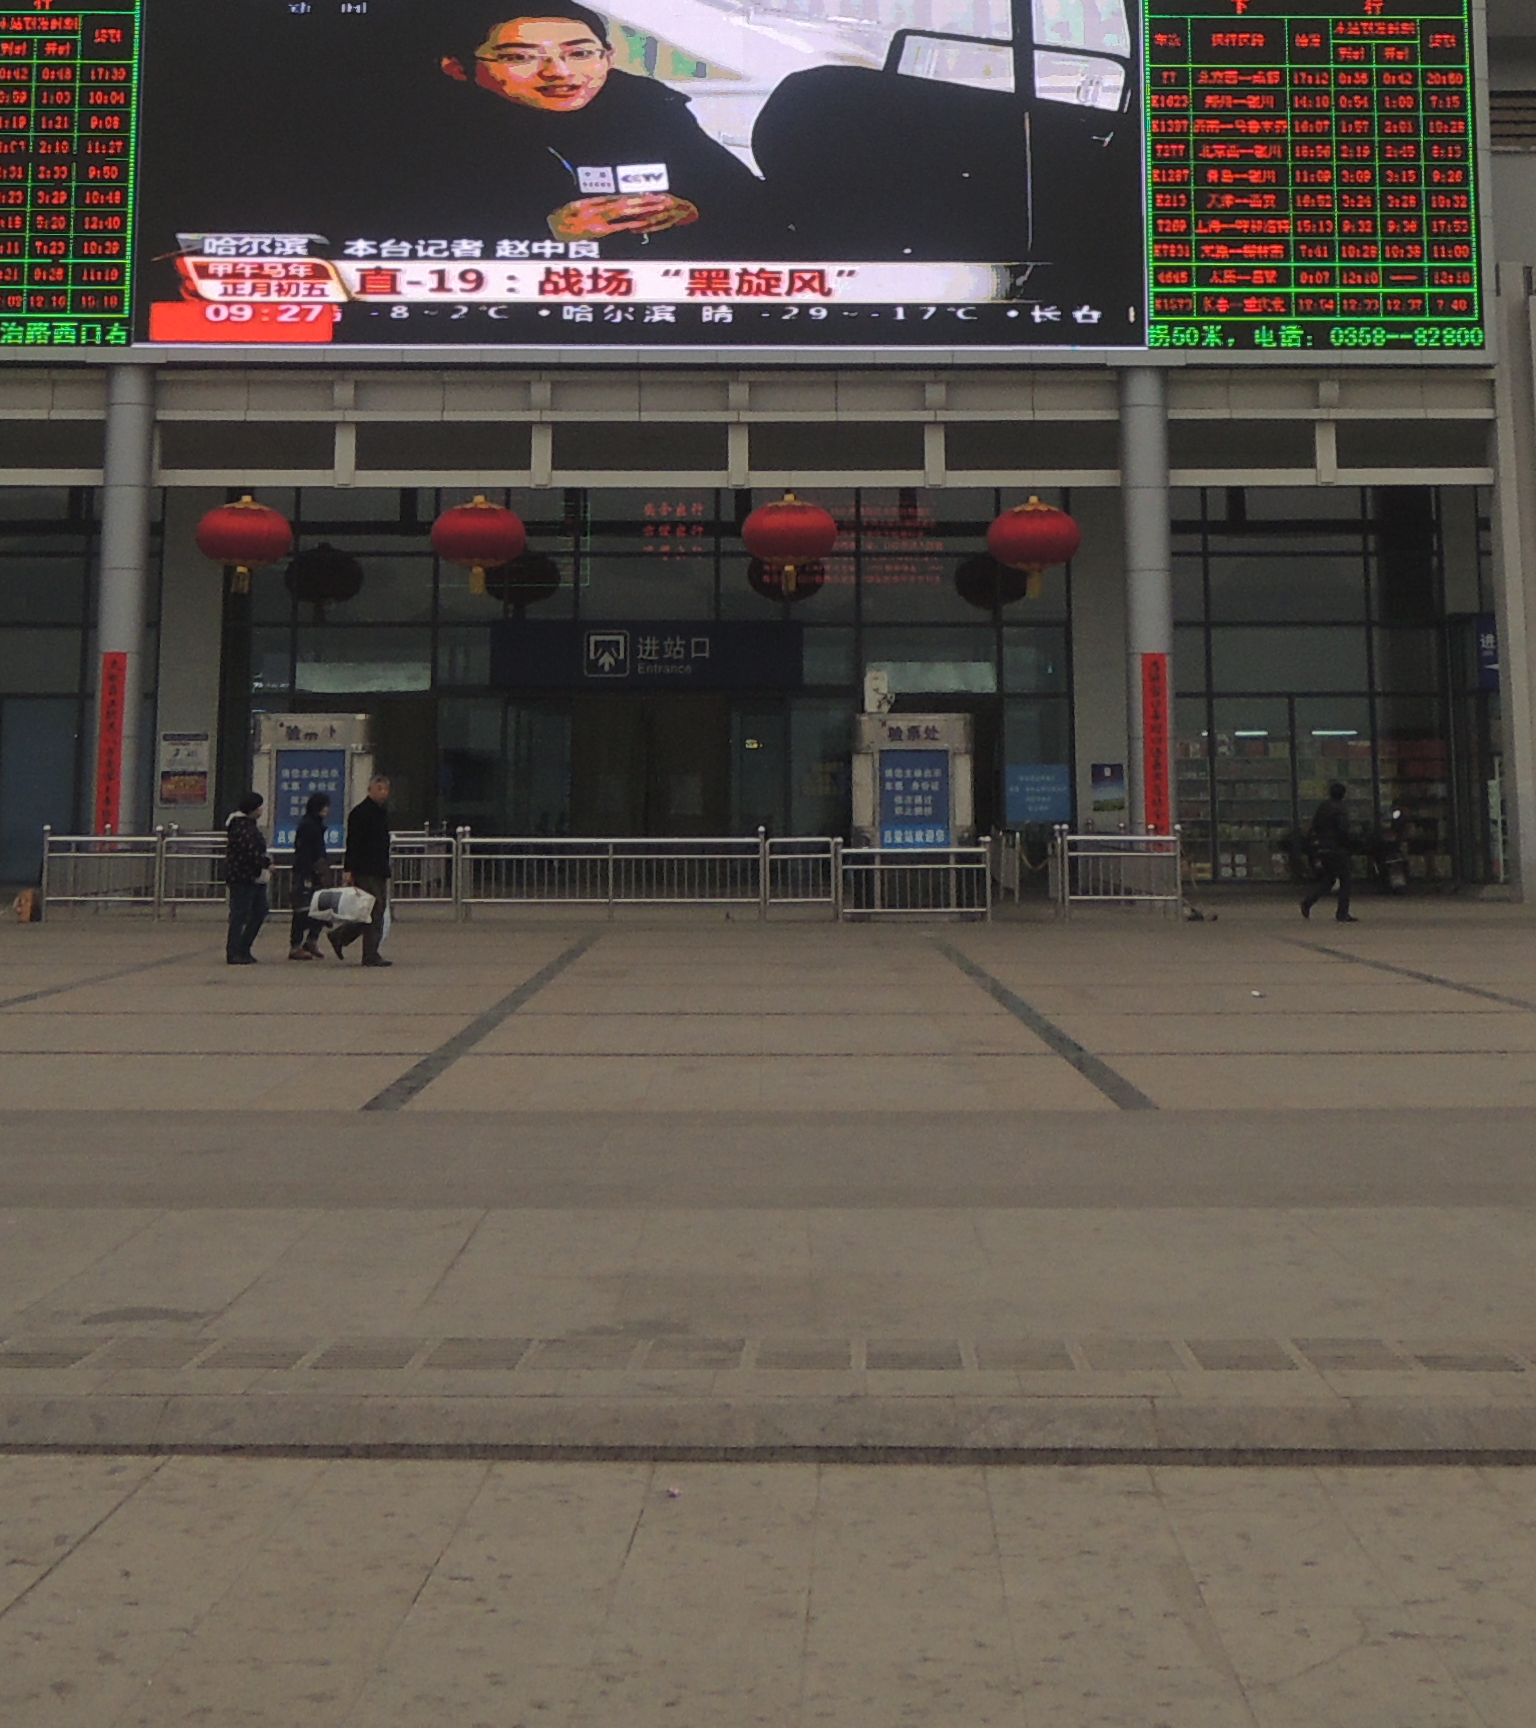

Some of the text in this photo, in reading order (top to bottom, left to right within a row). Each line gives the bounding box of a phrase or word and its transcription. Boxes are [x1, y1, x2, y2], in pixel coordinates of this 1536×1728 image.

[202, 237, 310, 257] 哈尔滨
[343, 238, 601, 259] 本台记者 赵中良
[207, 262, 314, 278] 甲午马年
[219, 280, 331, 298] 正月初五
[204, 304, 323, 322] 09:27
[700, 305, 734, 323] 晴
[636, 635, 710, 661] 进站口
[637, 663, 692, 674] Entrance
[887, 724, 941, 742] 验票处
